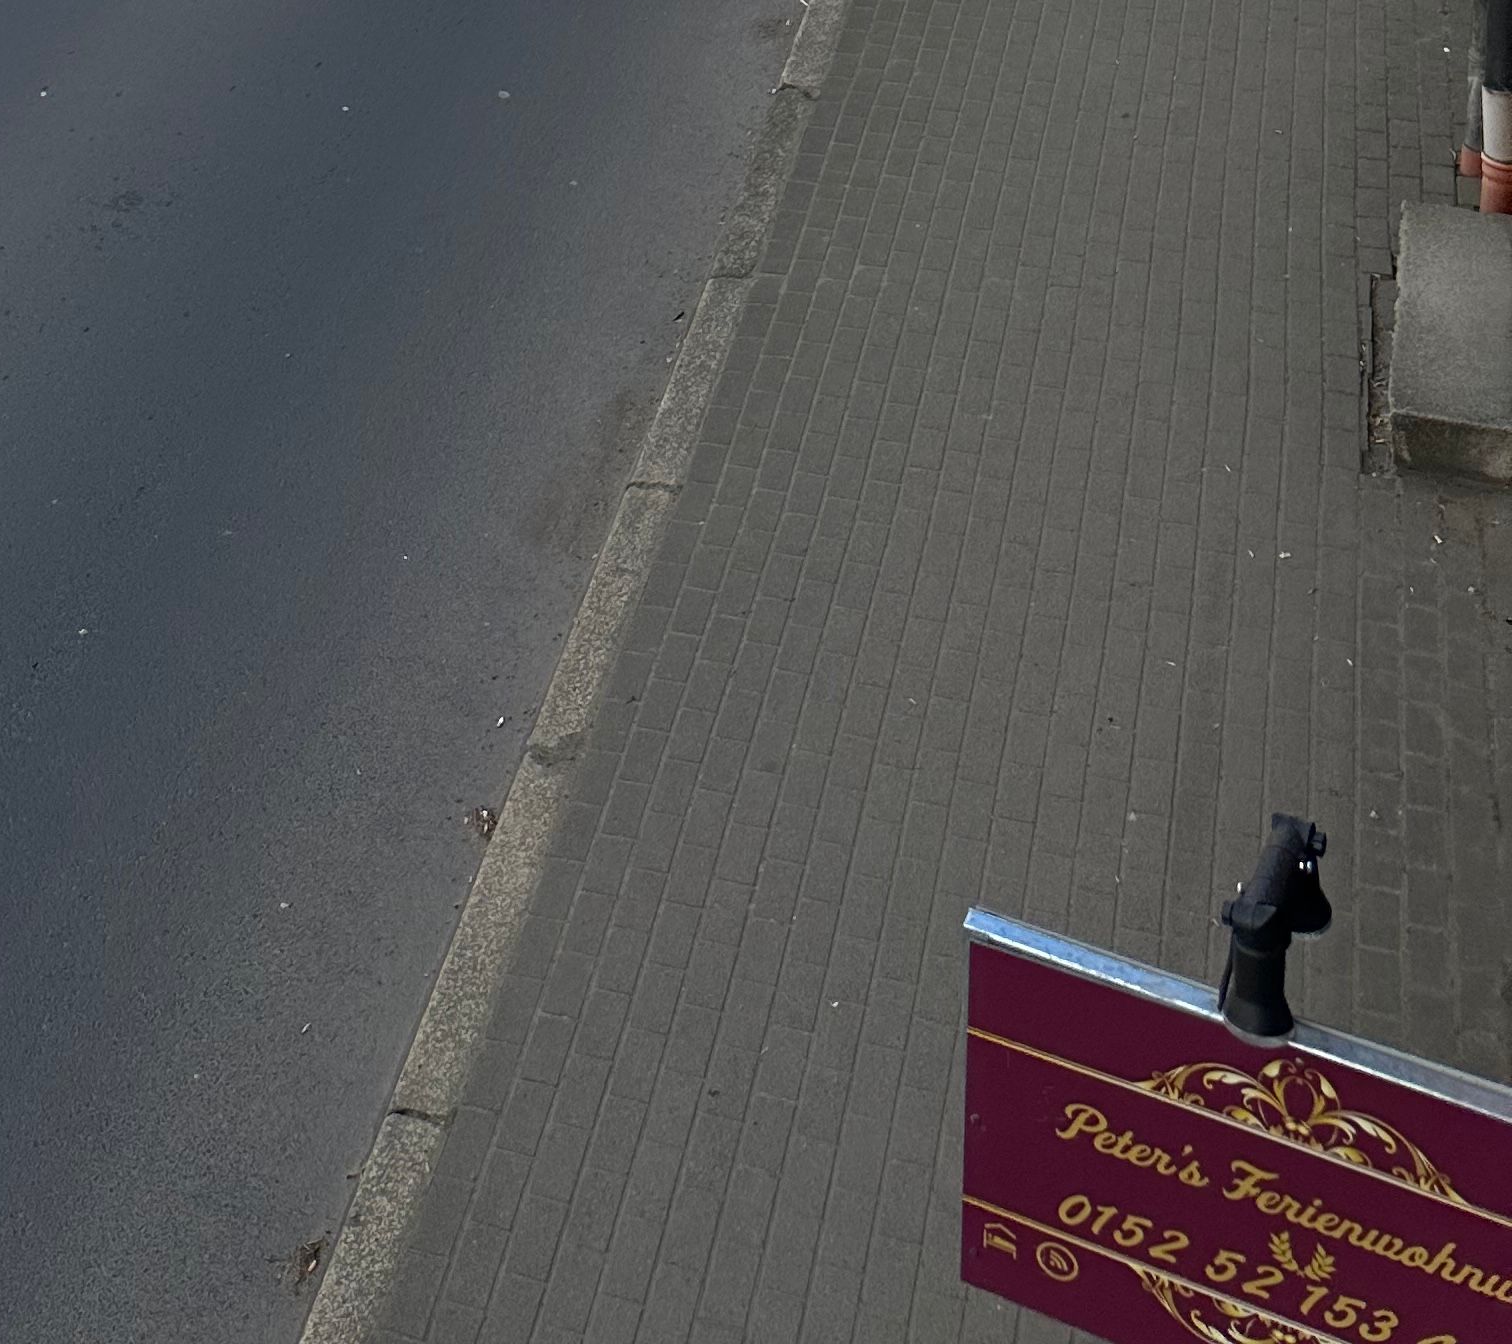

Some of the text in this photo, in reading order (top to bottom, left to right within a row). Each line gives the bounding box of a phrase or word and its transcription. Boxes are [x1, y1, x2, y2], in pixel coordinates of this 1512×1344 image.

[1055, 1103, 1210, 1187] Peter's
[1058, 1194, 1400, 1343] 0152 52 153
